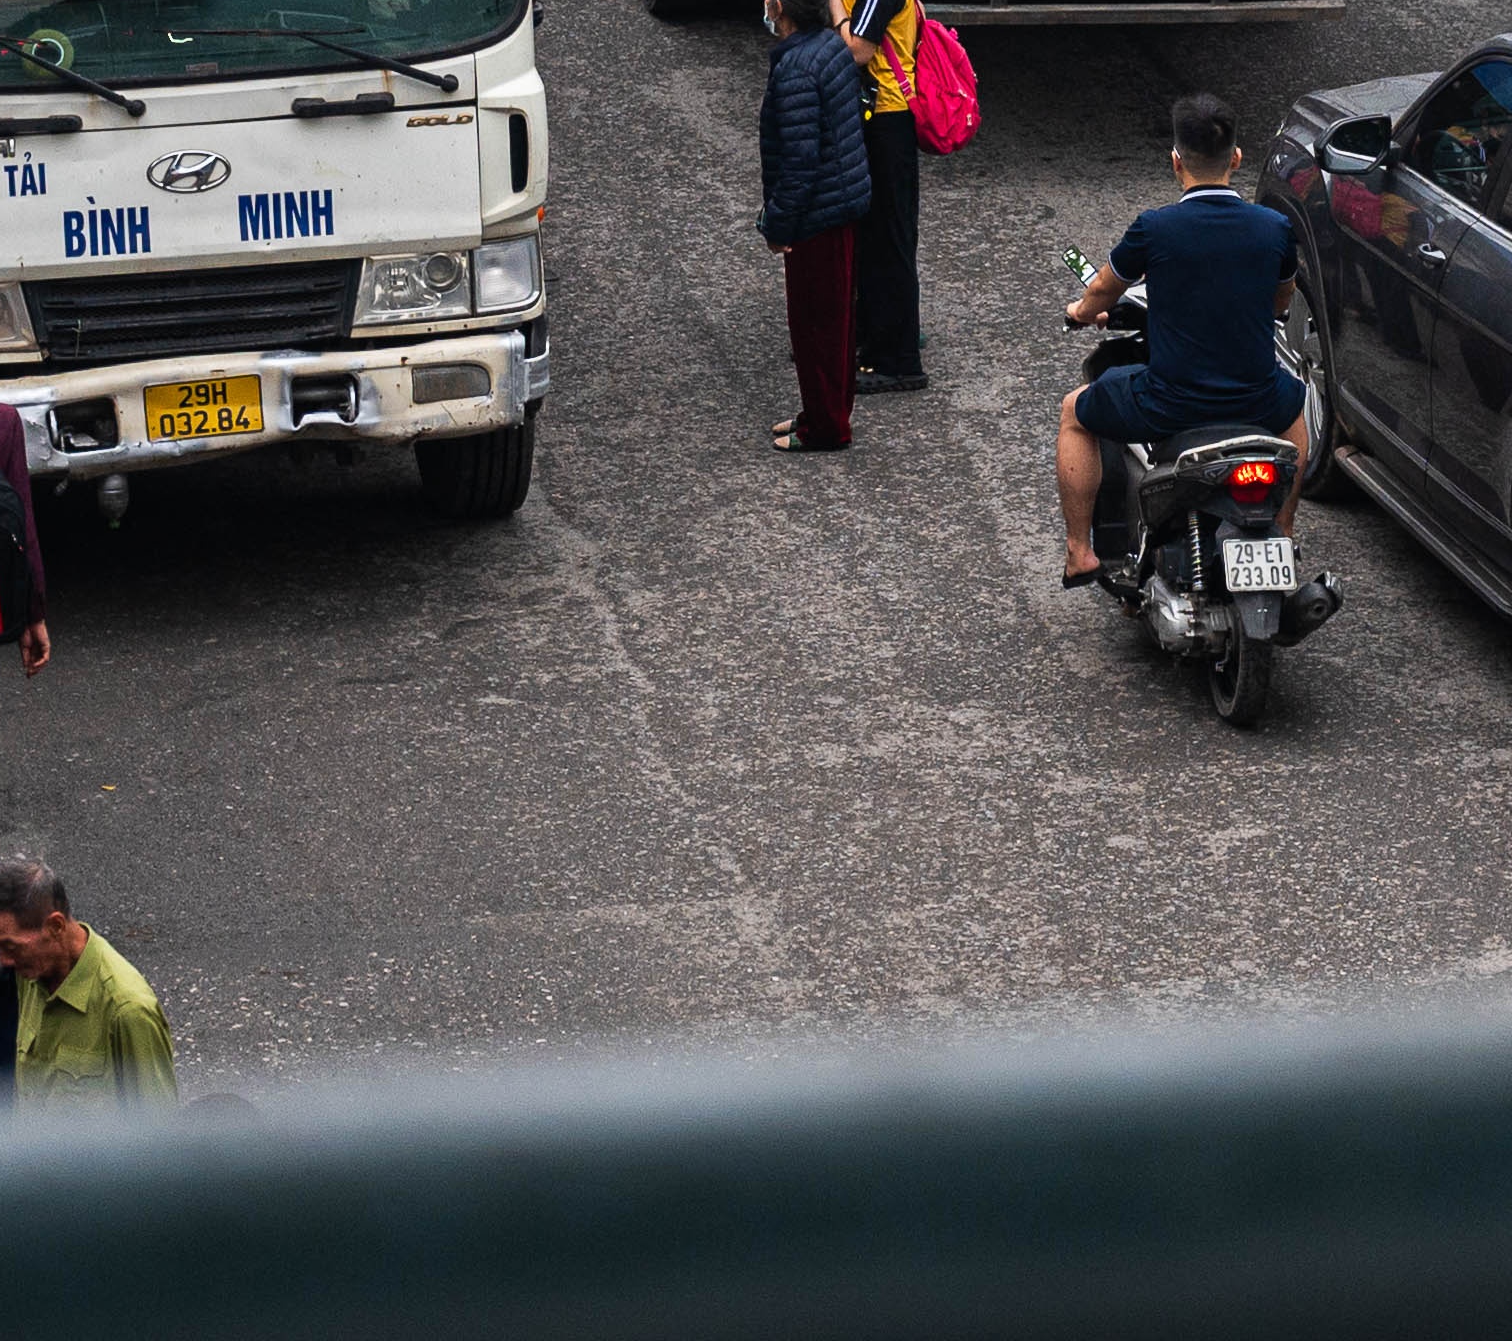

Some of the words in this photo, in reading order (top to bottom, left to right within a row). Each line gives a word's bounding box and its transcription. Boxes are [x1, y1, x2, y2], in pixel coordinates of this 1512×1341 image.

[406, 114, 474, 129] GOLD
[3, 153, 47, 197] TẢI
[63, 197, 152, 259] BÌNH
[238, 189, 335, 242] MINH
[178, 380, 228, 409] 29H
[159, 408, 251, 438] 032.84
[1234, 542, 1284, 566] 29-E1
[1231, 565, 1292, 588] 233.09
